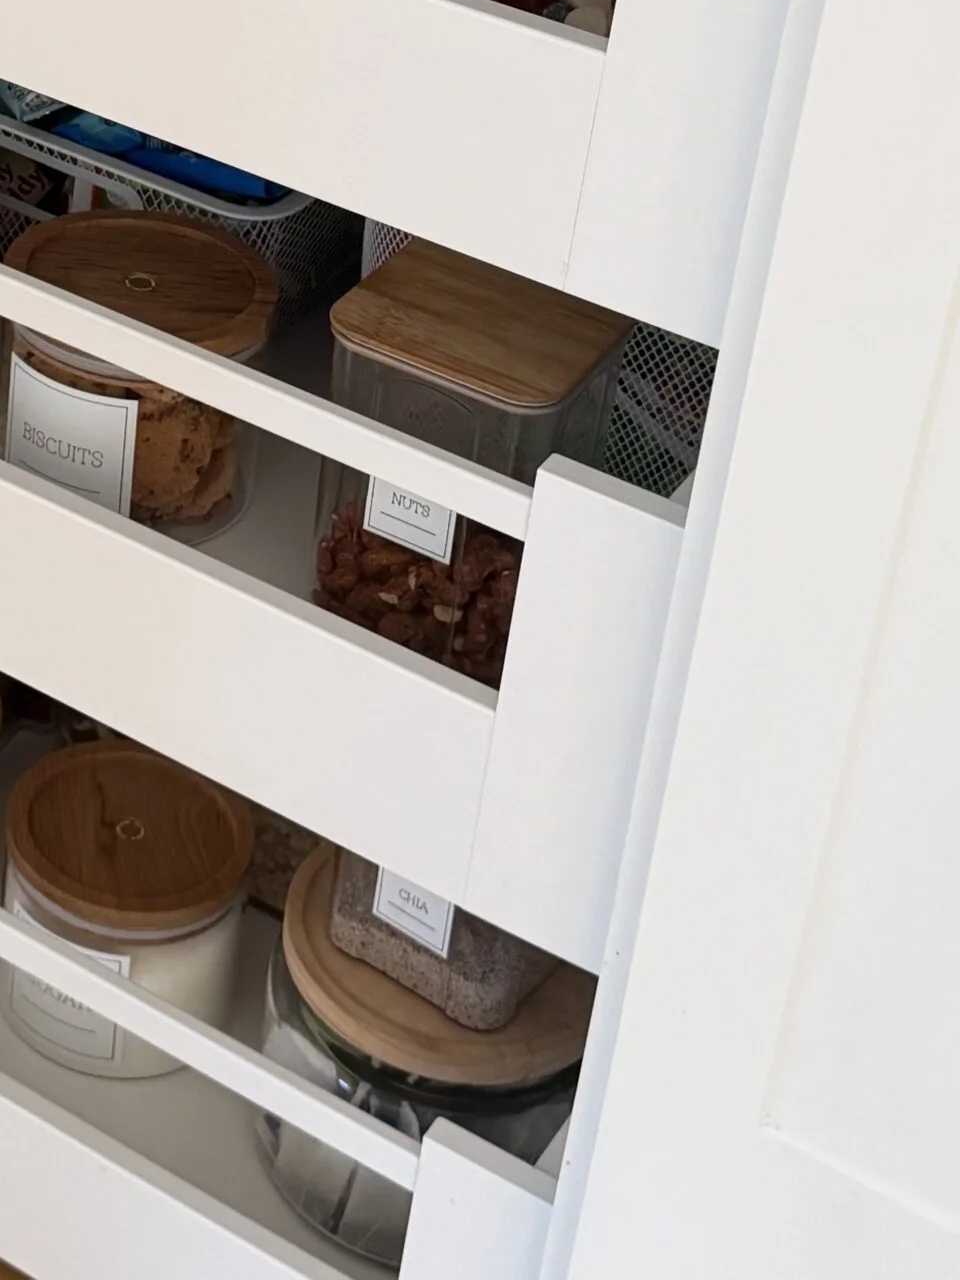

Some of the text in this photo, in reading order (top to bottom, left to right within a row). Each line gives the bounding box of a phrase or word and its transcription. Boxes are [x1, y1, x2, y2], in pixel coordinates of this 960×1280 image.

[21, 420, 105, 469] BISCUITS
[391, 491, 432, 519] NUTS
[398, 887, 430, 915] CHIA
